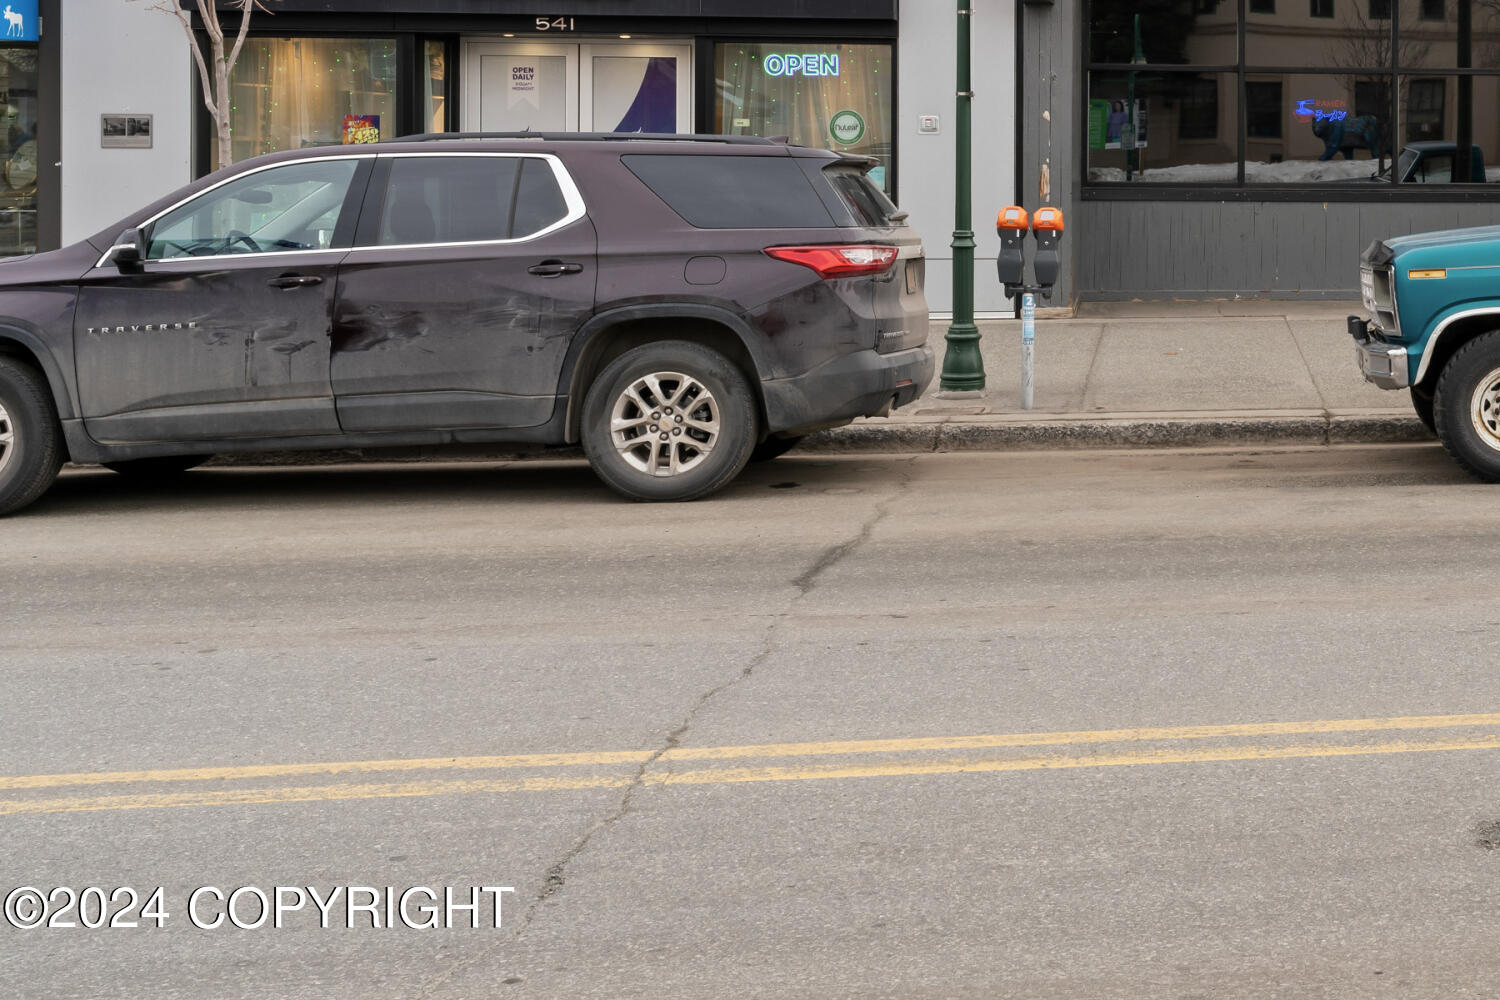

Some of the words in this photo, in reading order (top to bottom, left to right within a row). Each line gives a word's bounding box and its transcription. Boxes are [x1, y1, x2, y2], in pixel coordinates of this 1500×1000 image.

[535, 17, 575, 31] 541
[512, 66, 534, 74] OPEN
[764, 53, 840, 76] OPEN
[87, 321, 198, 334] TRAVERSE
